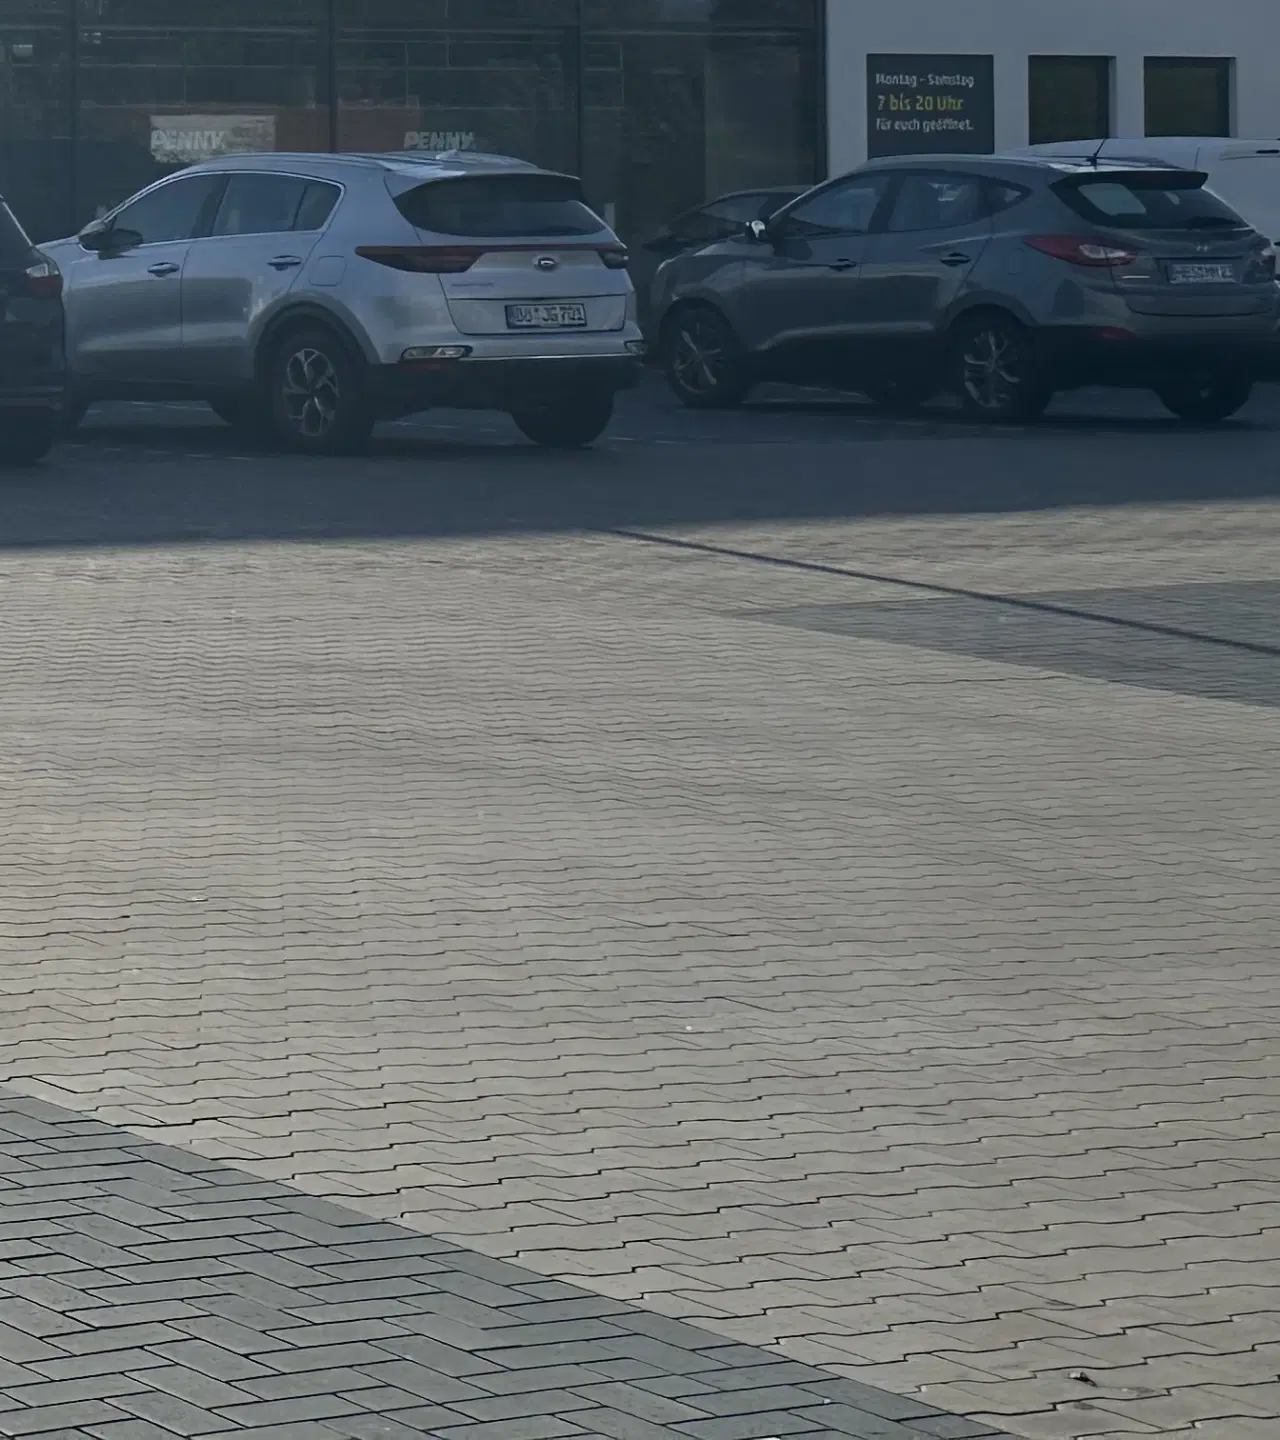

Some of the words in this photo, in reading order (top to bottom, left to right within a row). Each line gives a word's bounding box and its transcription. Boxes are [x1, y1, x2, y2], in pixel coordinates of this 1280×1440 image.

[875, 73, 917, 88] Montag
[927, 73, 975, 88] Samstag
[877, 95, 886, 111] 7
[889, 92, 911, 111] bis
[915, 95, 933, 111] 20
[936, 94, 964, 111] Uhr
